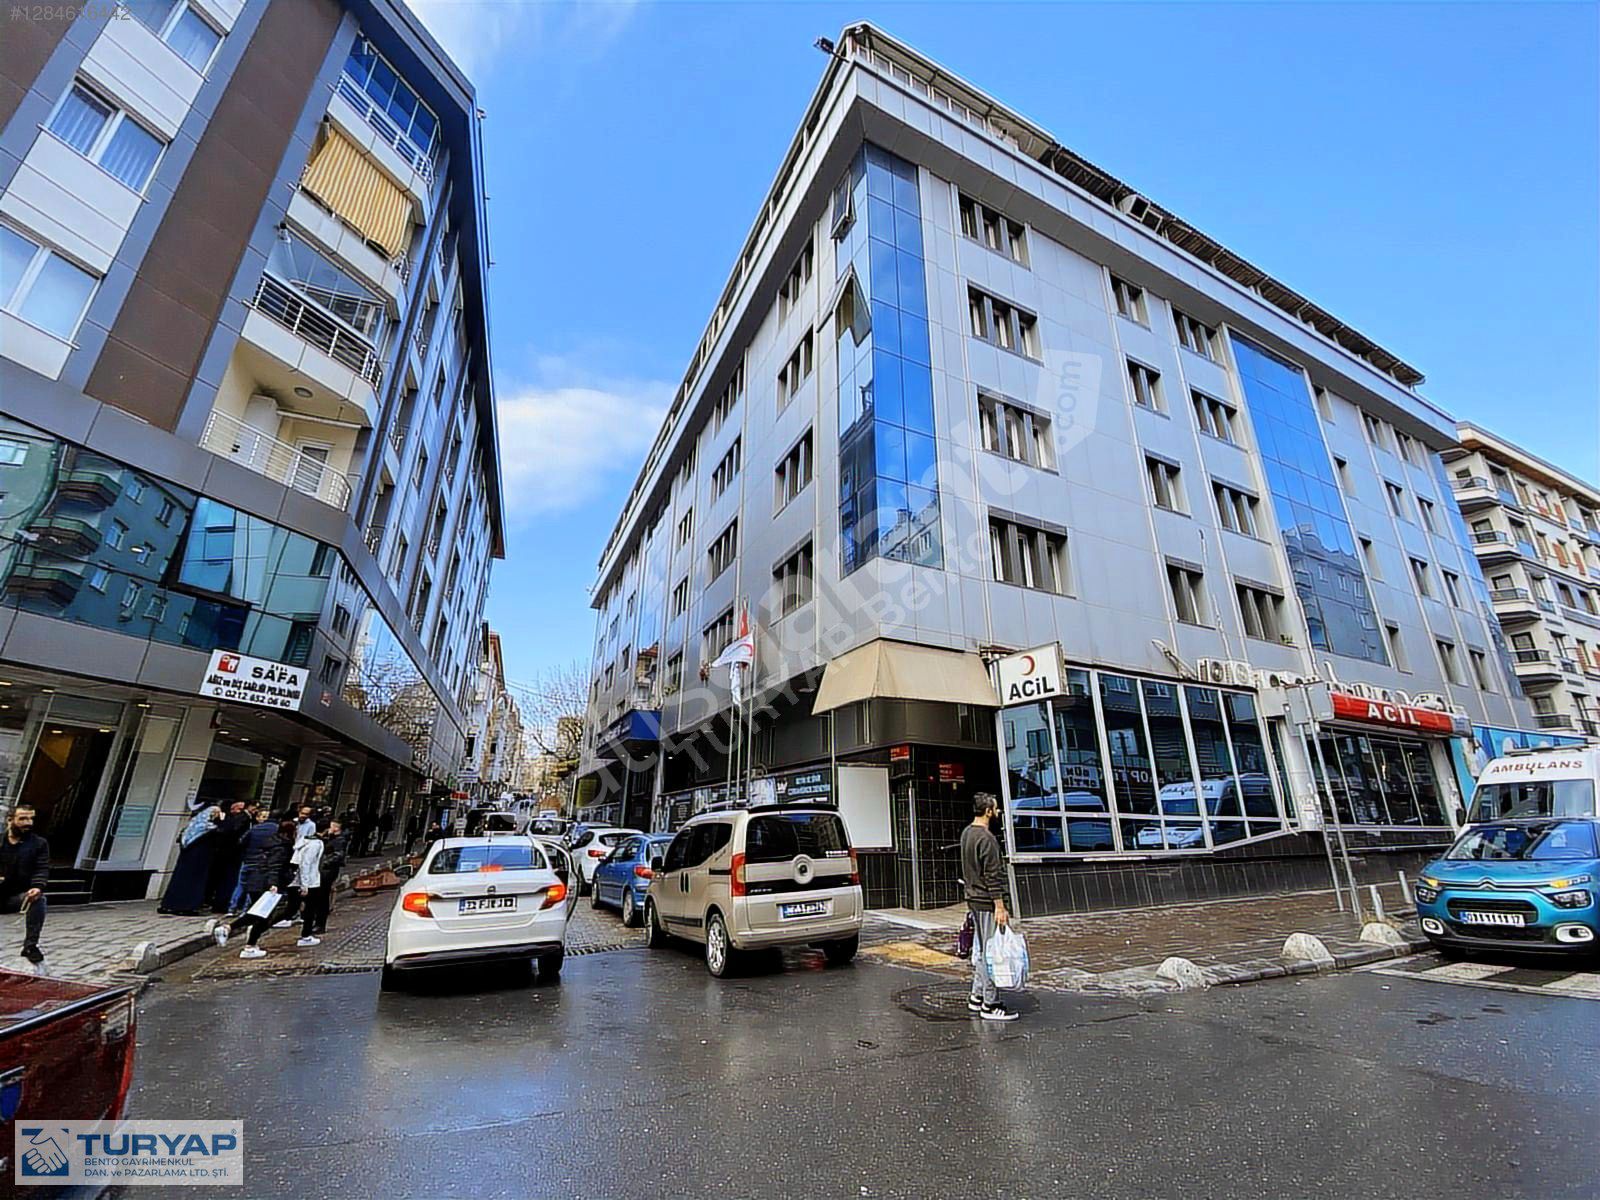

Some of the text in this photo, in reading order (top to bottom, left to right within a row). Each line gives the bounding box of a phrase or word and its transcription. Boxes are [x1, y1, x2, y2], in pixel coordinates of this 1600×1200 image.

[251, 666, 298, 686] SAFA
[225, 689, 248, 700] 0212
[1487, 760, 1582, 773] AMBULANS
